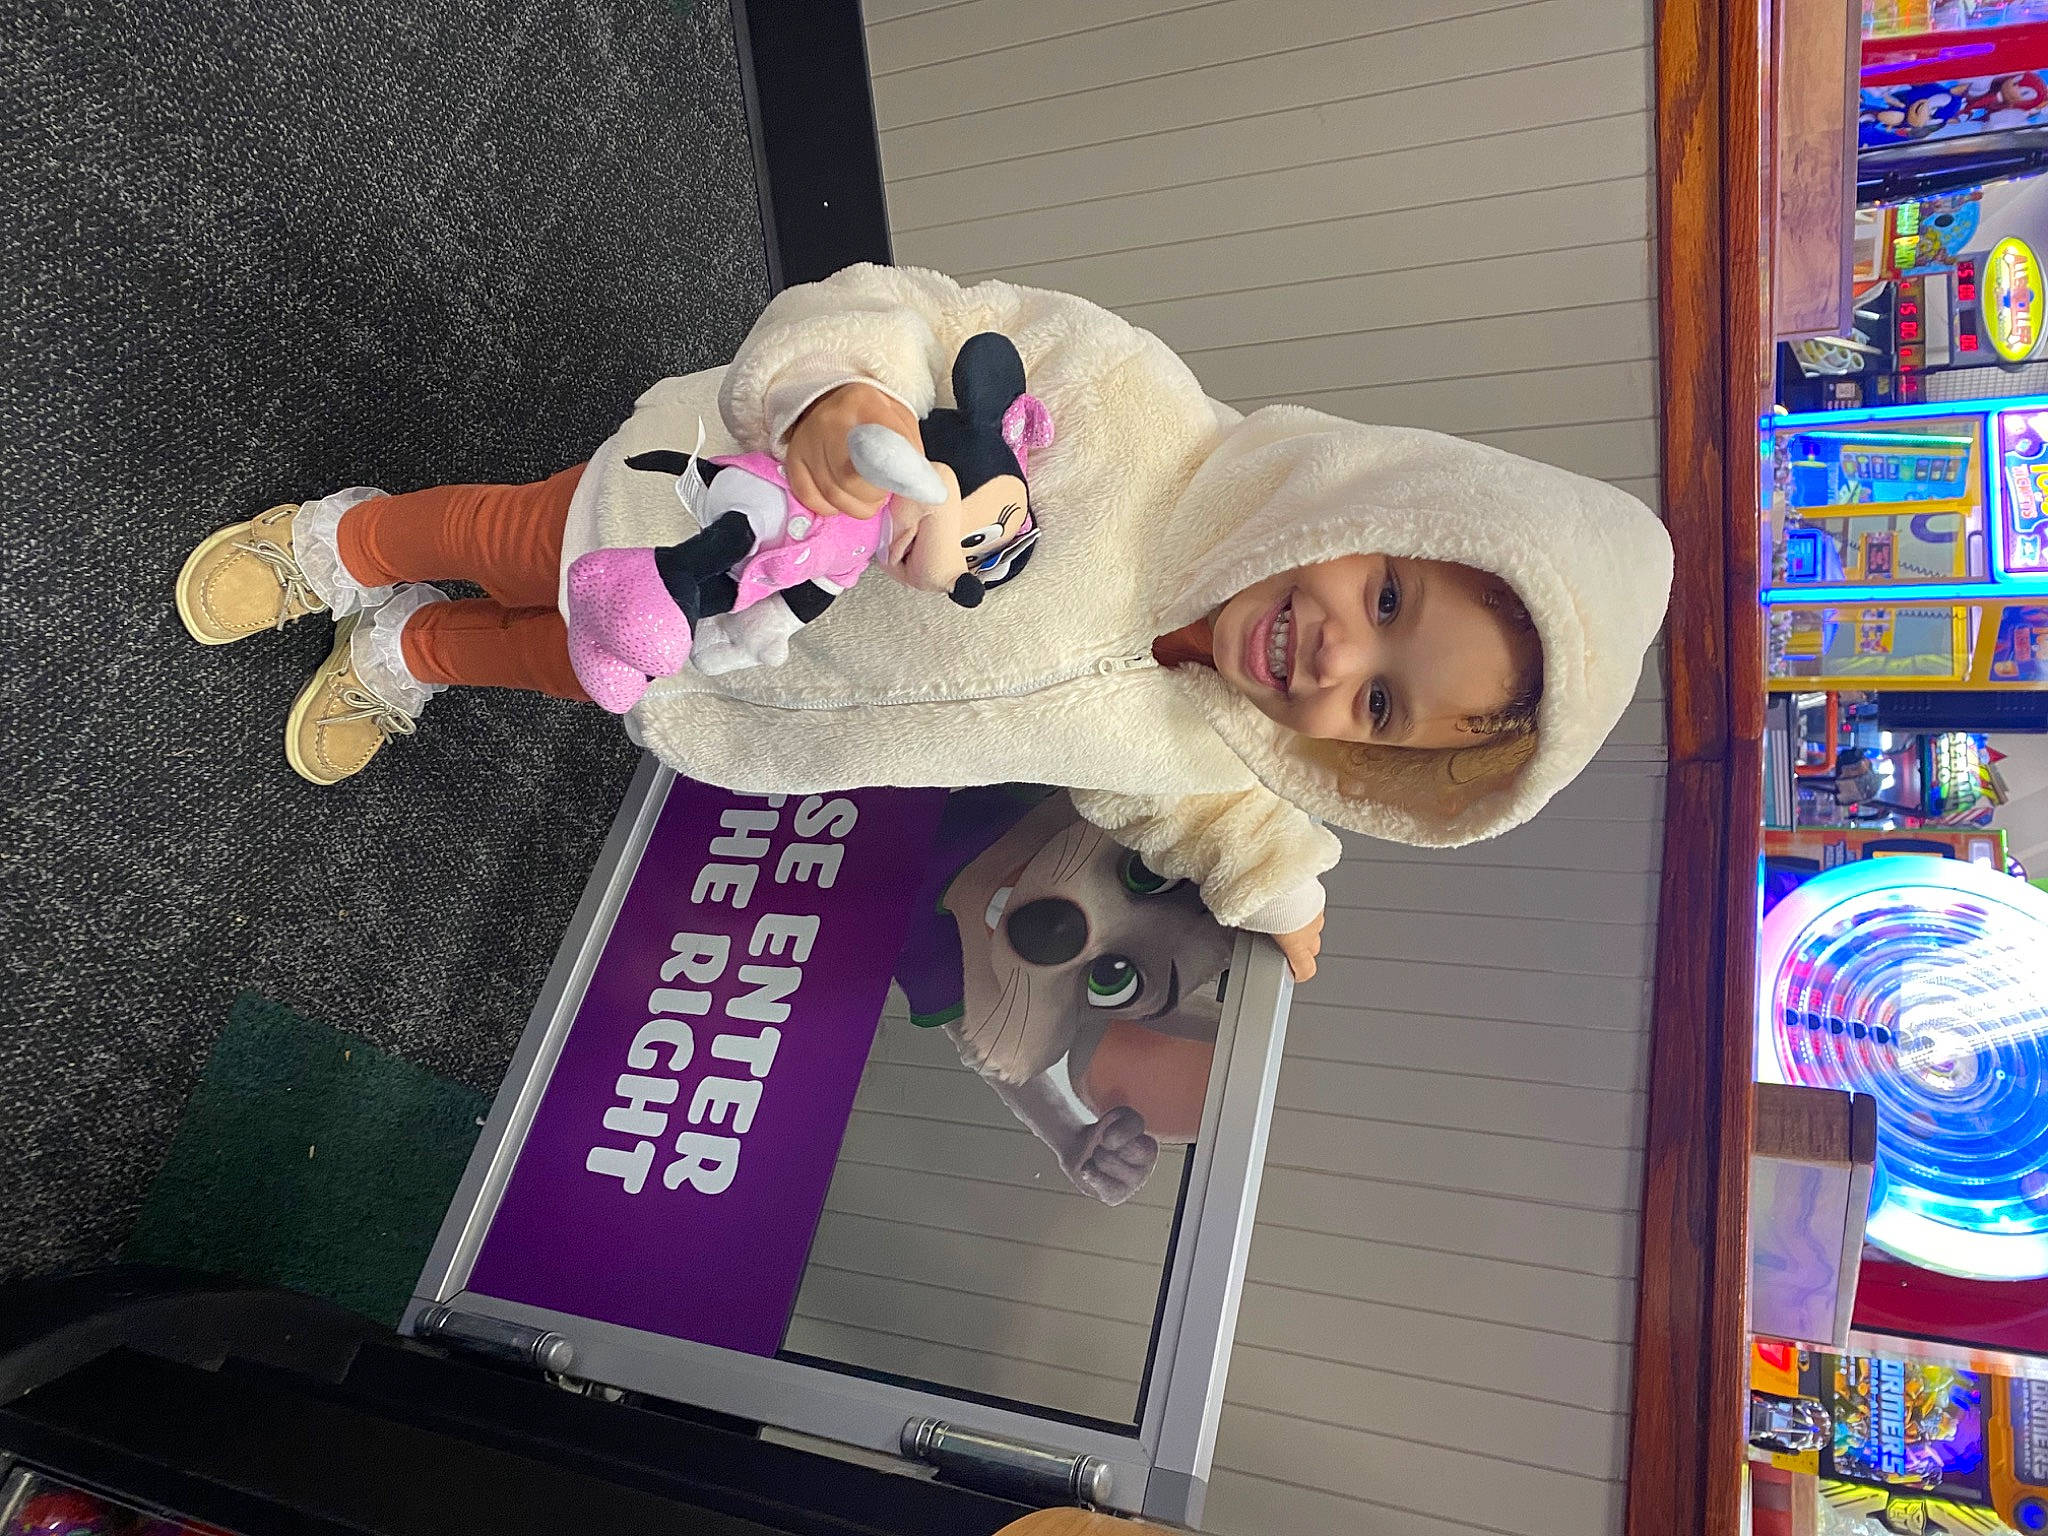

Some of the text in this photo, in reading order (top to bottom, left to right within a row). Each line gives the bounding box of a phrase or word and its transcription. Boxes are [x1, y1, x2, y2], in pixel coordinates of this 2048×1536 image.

[585, 932, 732, 1195] RIGHT
[662, 795, 859, 1195] SE ENTER
